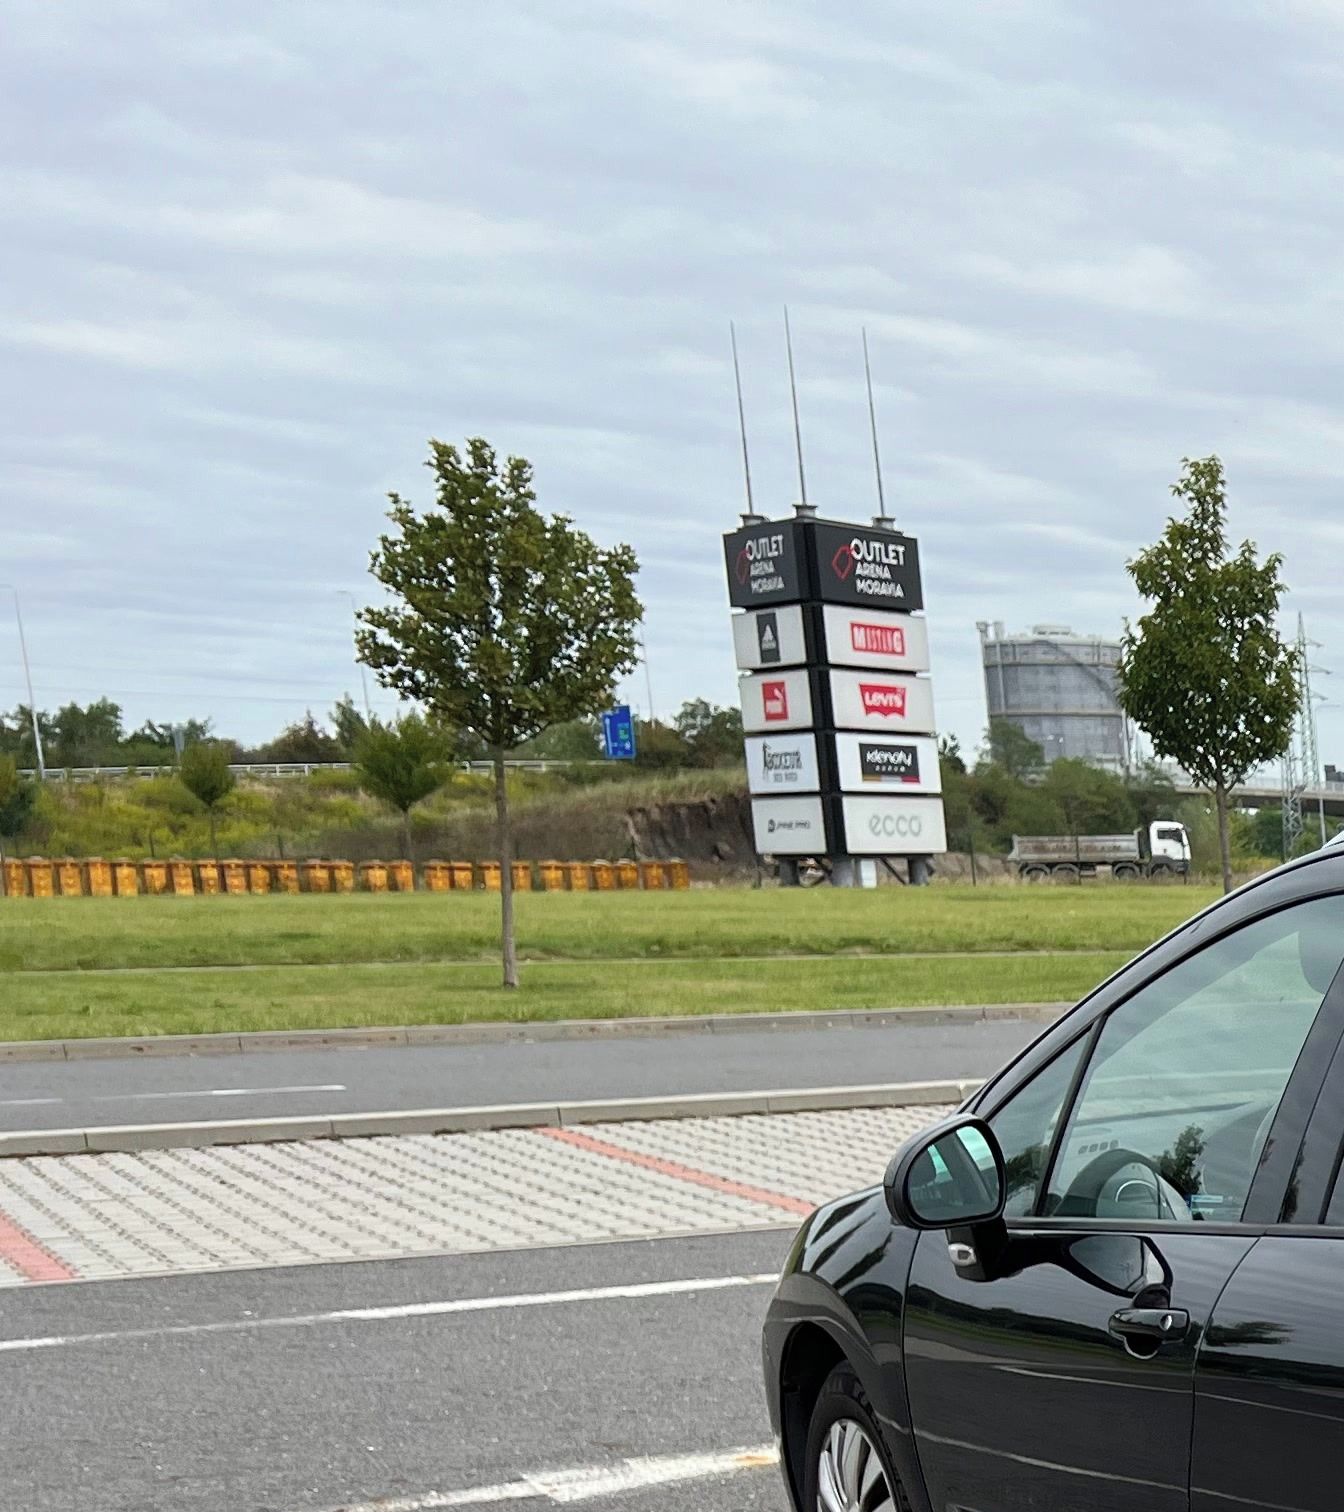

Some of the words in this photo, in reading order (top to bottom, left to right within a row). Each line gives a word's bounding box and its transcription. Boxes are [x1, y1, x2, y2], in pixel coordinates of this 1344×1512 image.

[745, 534, 784, 561] OUTLET
[850, 538, 905, 566] OUTLET
[855, 562, 892, 579] ARENA
[856, 578, 905, 598] MORAVIA
[868, 813, 923, 837] ecco
